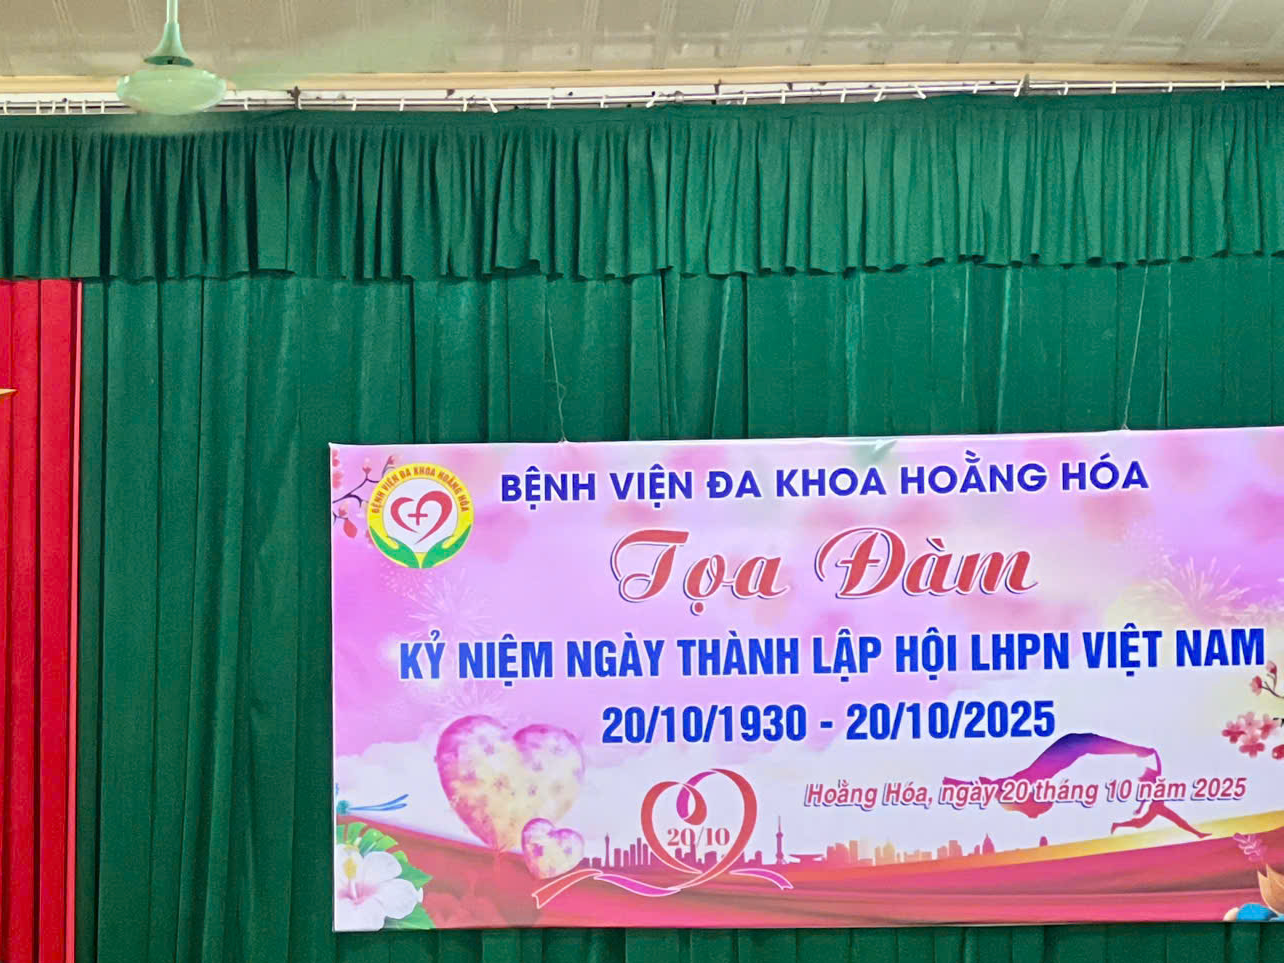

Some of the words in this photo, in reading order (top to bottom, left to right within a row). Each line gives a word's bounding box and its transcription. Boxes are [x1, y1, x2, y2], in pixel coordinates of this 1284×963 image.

[501, 465, 596, 510] BỆNH
[609, 463, 692, 508] VIỆN
[706, 470, 762, 498] ĐA
[776, 467, 887, 497] KHOA
[900, 450, 1047, 494] HOẰNG
[1061, 452, 1149, 491] HÓA
[610, 529, 790, 616] Tọa
[814, 526, 1039, 599] Đàm
[400, 629, 446, 679] KỶ
[458, 633, 554, 687] NIỆM
[566, 632, 665, 678] NGÀY
[676, 630, 799, 676] THÀNH
[812, 628, 882, 683] LẬP
[895, 626, 957, 681] HỘI
[971, 632, 1069, 671] LHPN
[1082, 622, 1163, 677] VIỆT
[1176, 628, 1265, 667] NAM
[602, 704, 807, 744] 20/10/1930
[846, 700, 1055, 741] 20/10/2025
[805, 779, 878, 811] Hoằng
[883, 780, 932, 808] Hóa,
[939, 777, 997, 809] ngày
[1000, 781, 1028, 804] 20
[1034, 779, 1098, 807] tháng
[1106, 779, 1132, 802] 10
[1138, 778, 1186, 801] năm
[1192, 777, 1247, 801] 2025
[667, 826, 730, 847] 20/10
